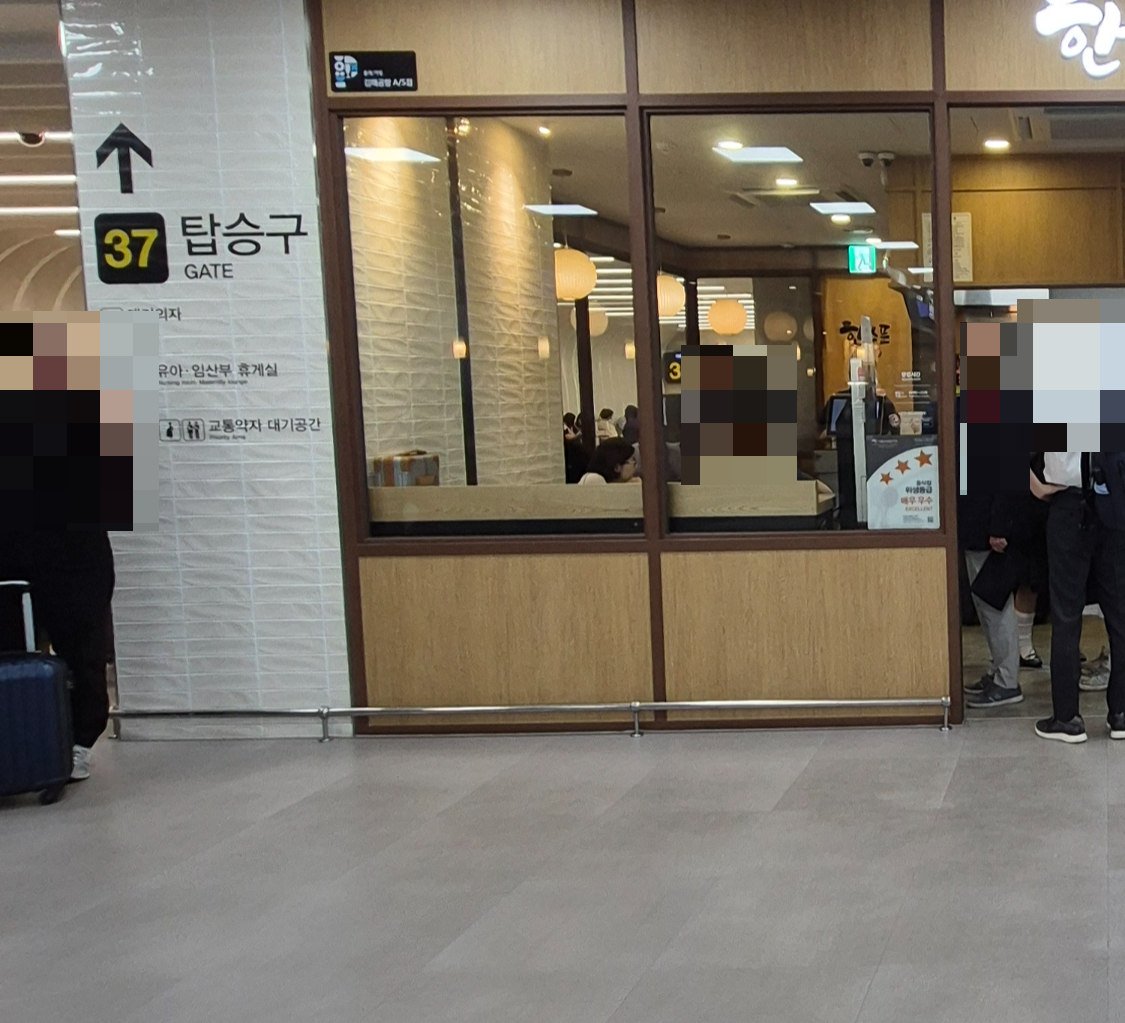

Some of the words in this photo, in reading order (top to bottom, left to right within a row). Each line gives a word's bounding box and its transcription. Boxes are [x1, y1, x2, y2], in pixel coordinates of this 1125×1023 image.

[181, 213, 308, 256] 탑승구
[104, 229, 158, 269] 37
[184, 263, 234, 279] GATE
[238, 363, 278, 378] 휴게실
[208, 419, 262, 433] 교통약자
[268, 418, 321, 432] 대기공간
